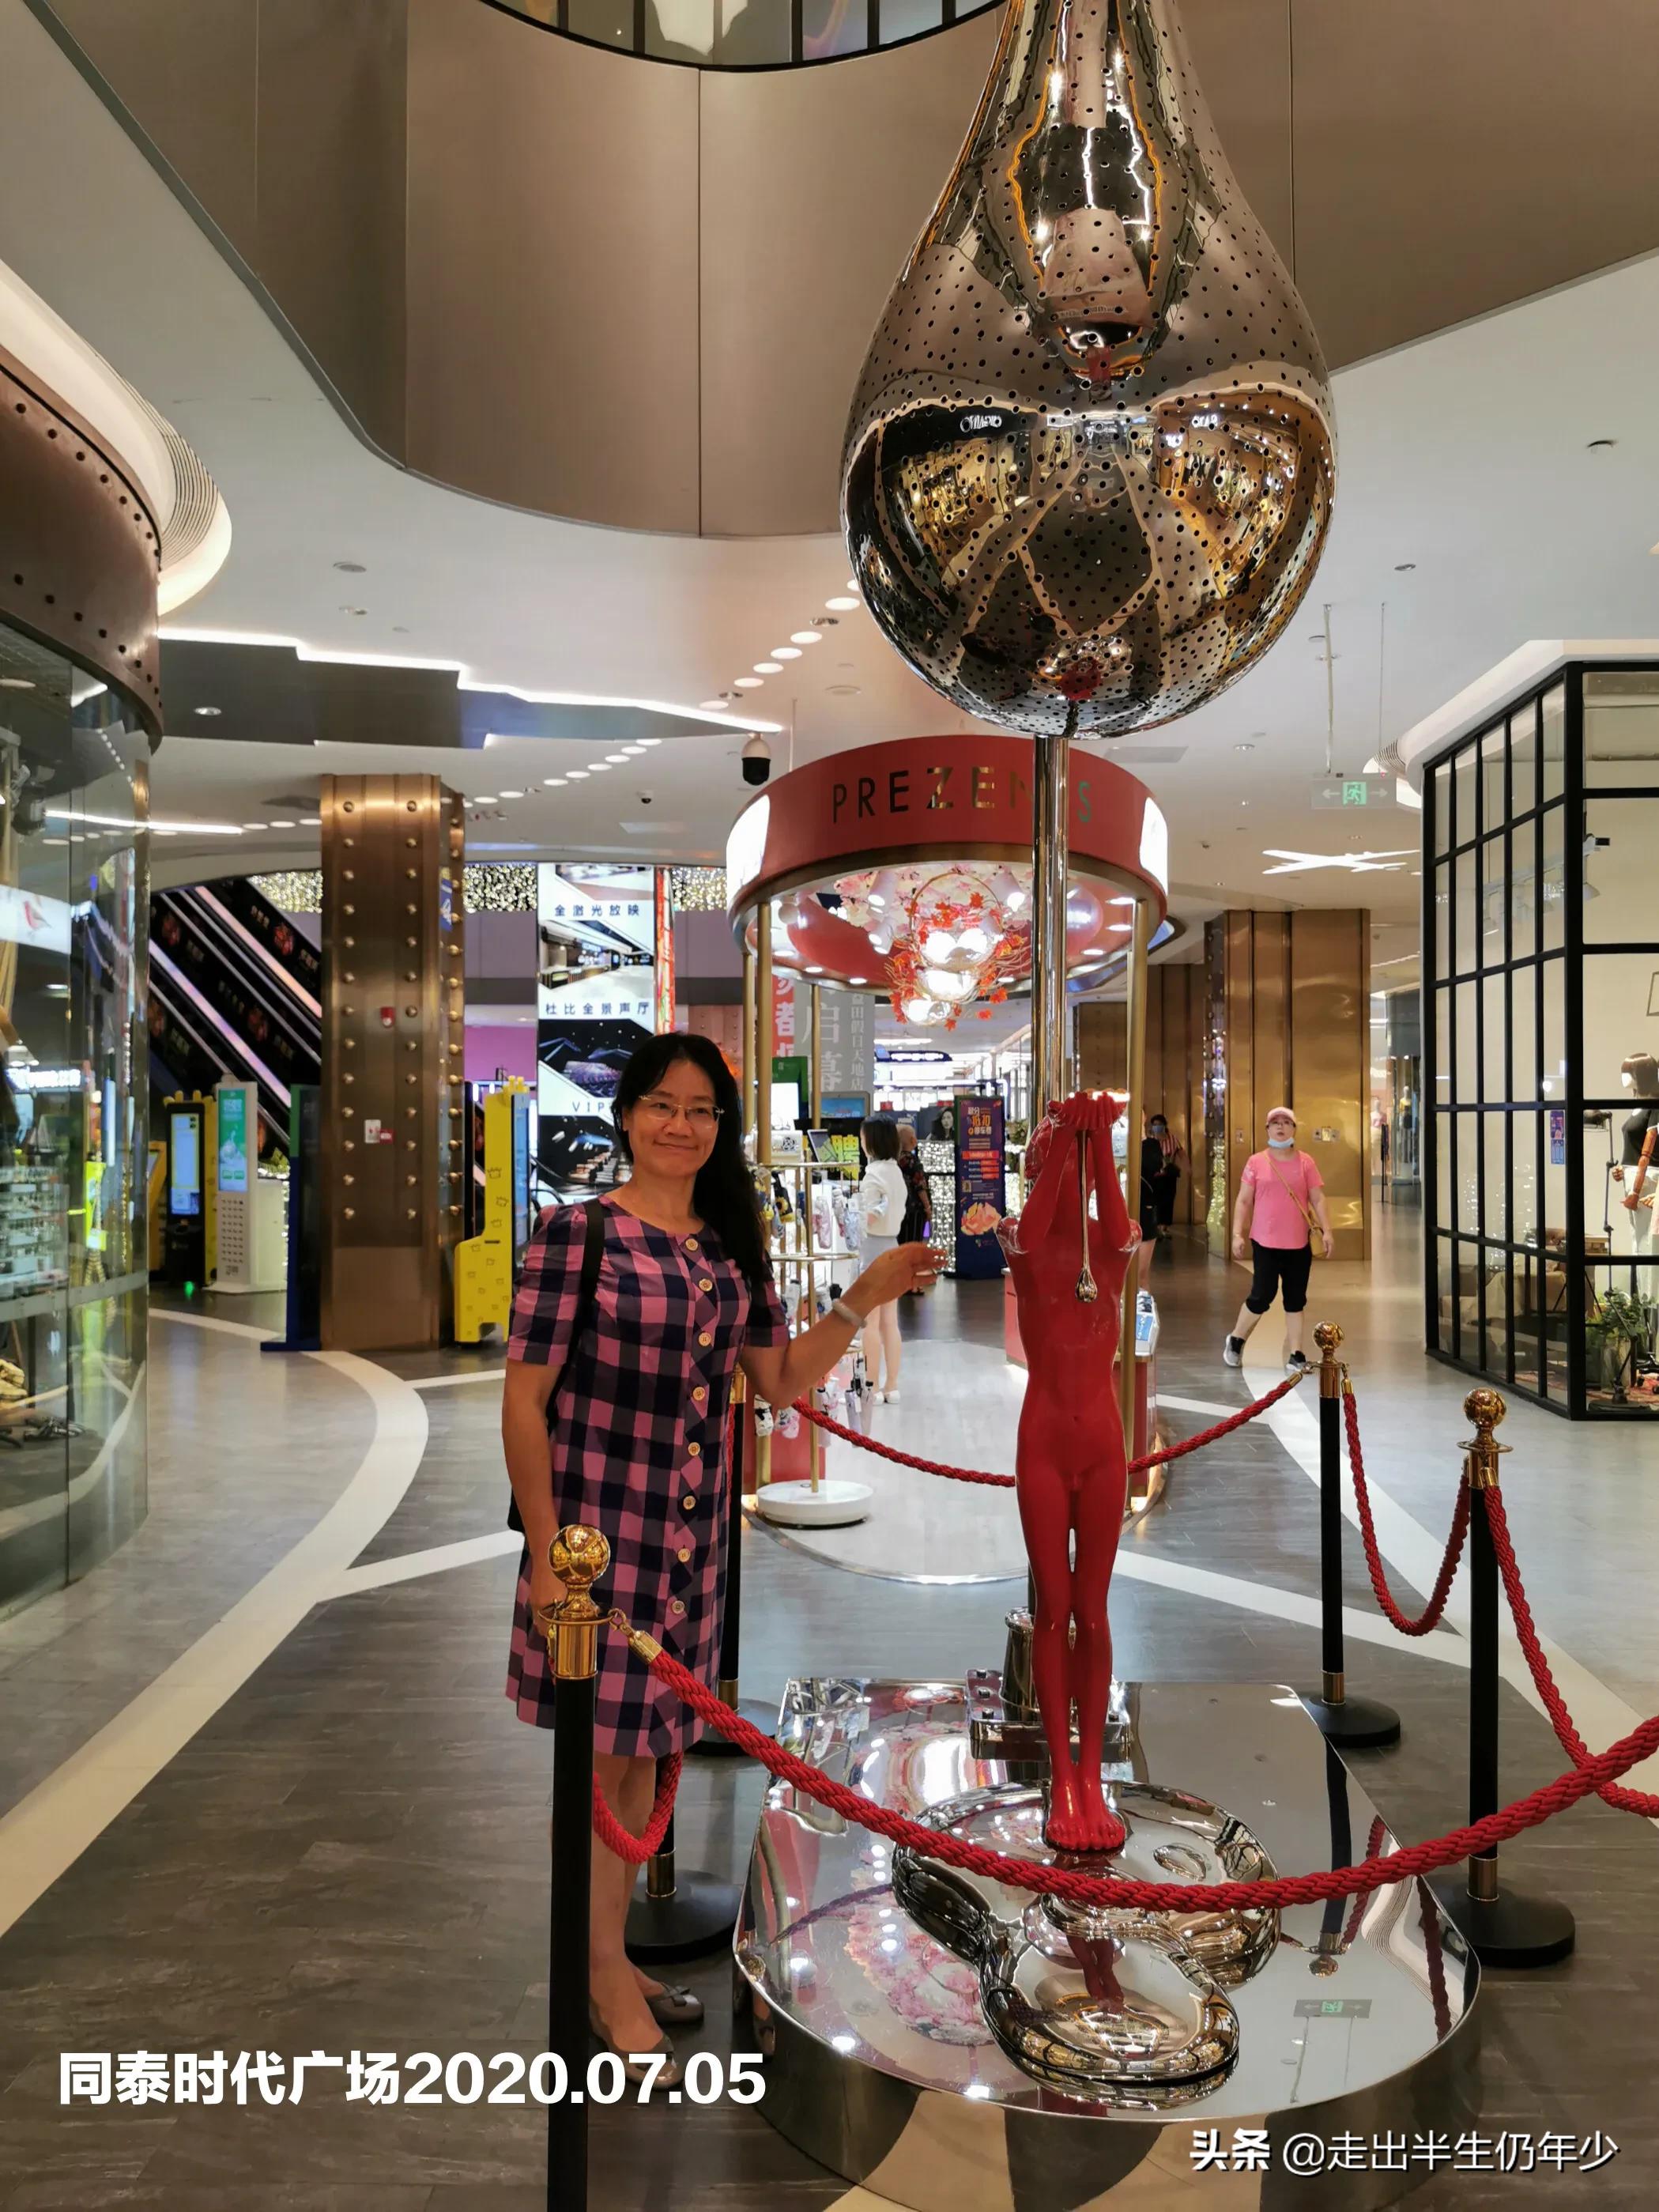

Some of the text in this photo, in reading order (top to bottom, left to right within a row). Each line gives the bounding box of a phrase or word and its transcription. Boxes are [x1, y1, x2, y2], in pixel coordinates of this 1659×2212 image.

[832, 766, 1092, 825] PREZENS
[545, 1002, 650, 1016] 杜比全景声厅
